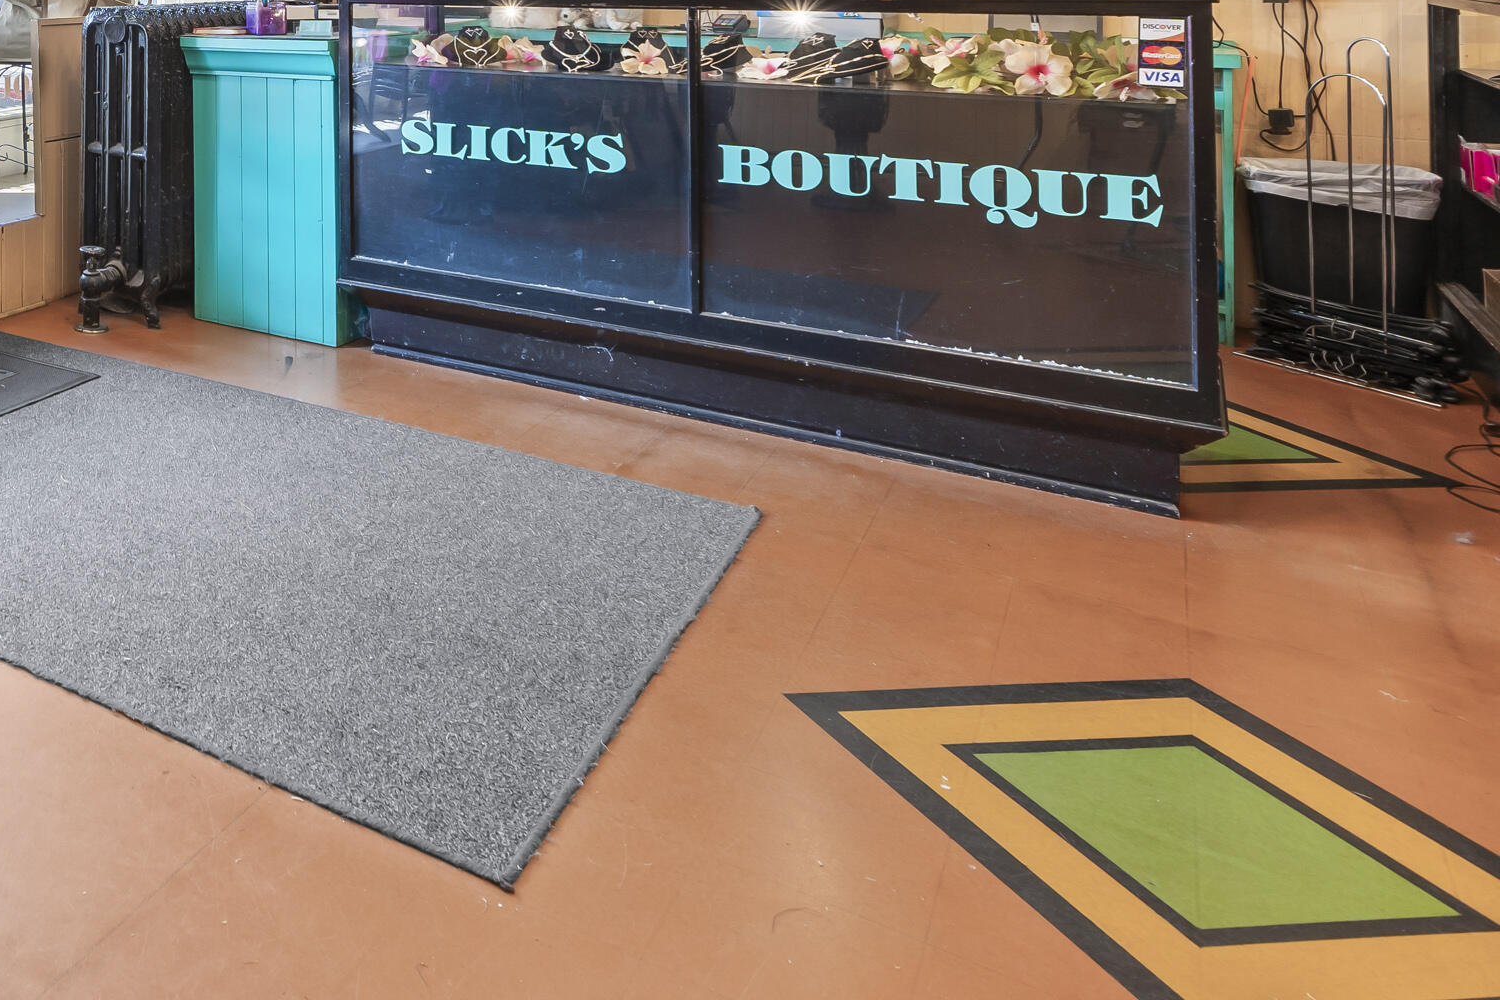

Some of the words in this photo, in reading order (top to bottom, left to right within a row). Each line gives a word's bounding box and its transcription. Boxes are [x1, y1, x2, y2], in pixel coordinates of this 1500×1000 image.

[1143, 71, 1181, 83] VISA
[401, 118, 627, 175] SLICK'S
[717, 144, 1164, 228] BOUTIQUE
